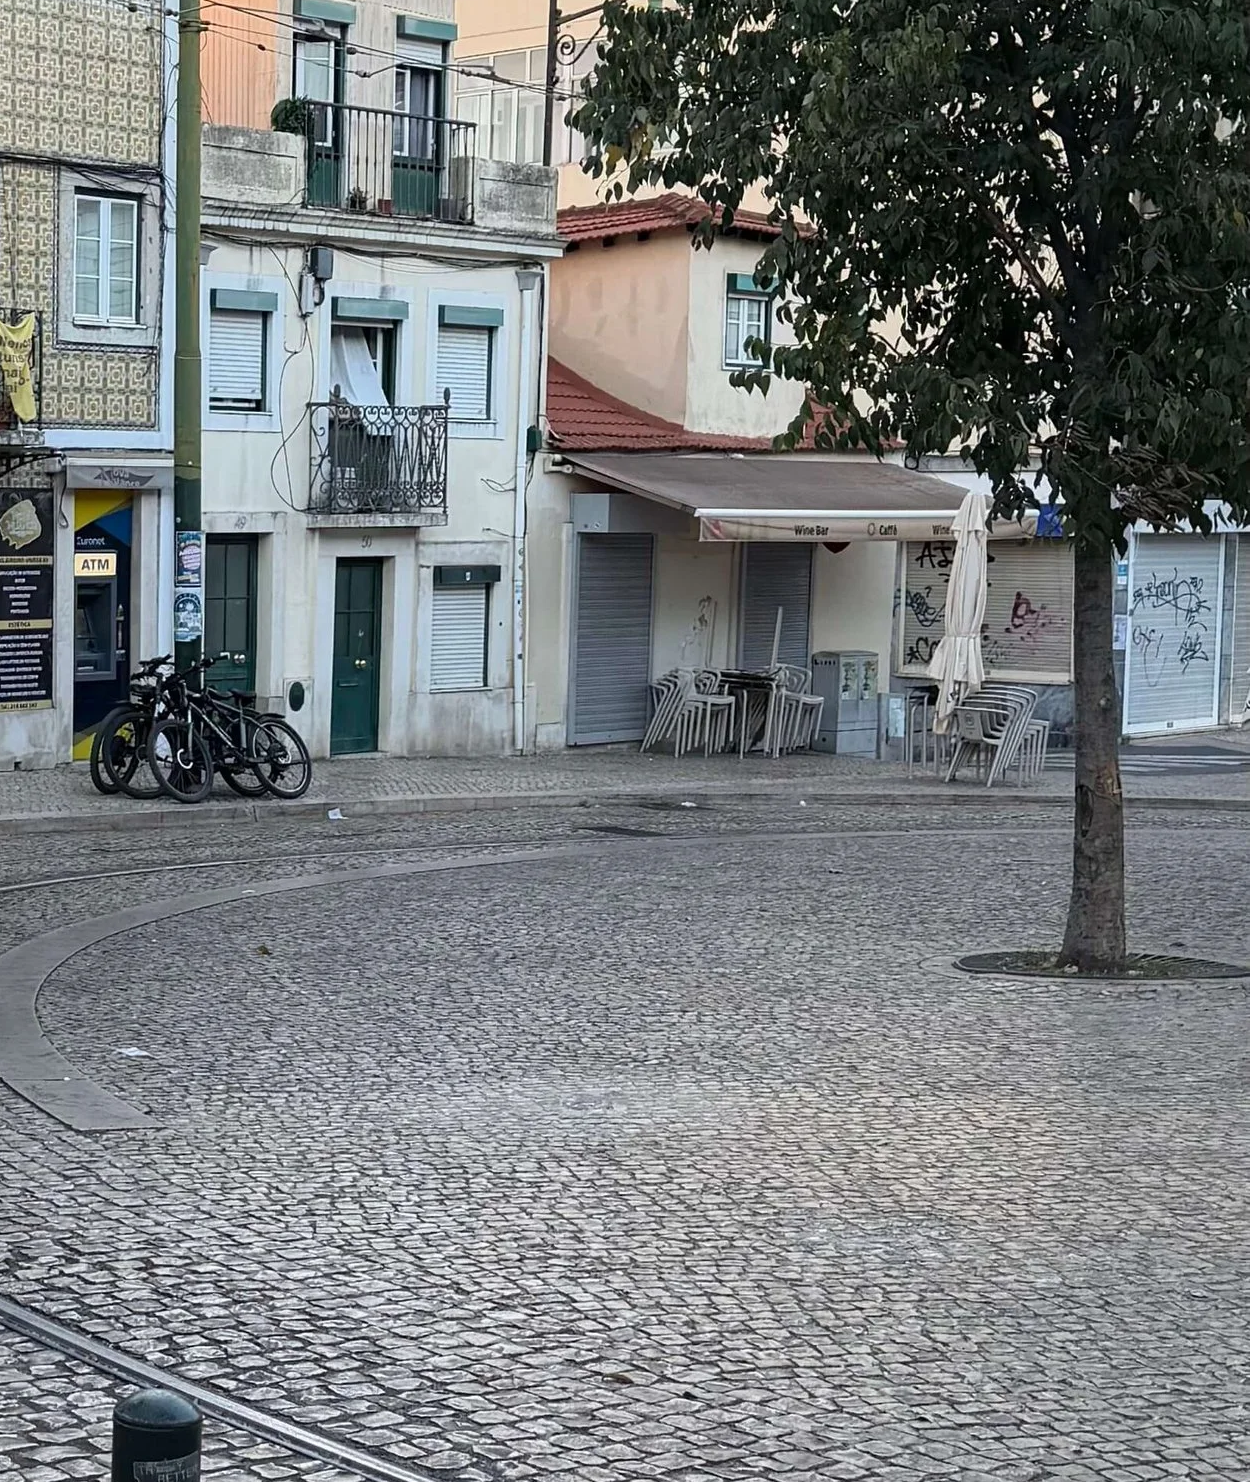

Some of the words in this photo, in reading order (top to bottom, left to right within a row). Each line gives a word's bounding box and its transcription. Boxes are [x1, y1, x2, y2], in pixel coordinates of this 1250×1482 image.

[794, 525, 815, 536] Wine
[815, 525, 829, 536] Bar
[932, 525, 951, 536] Wine
[77, 537, 106, 546] Euronet
[81, 559, 109, 571] ATM
